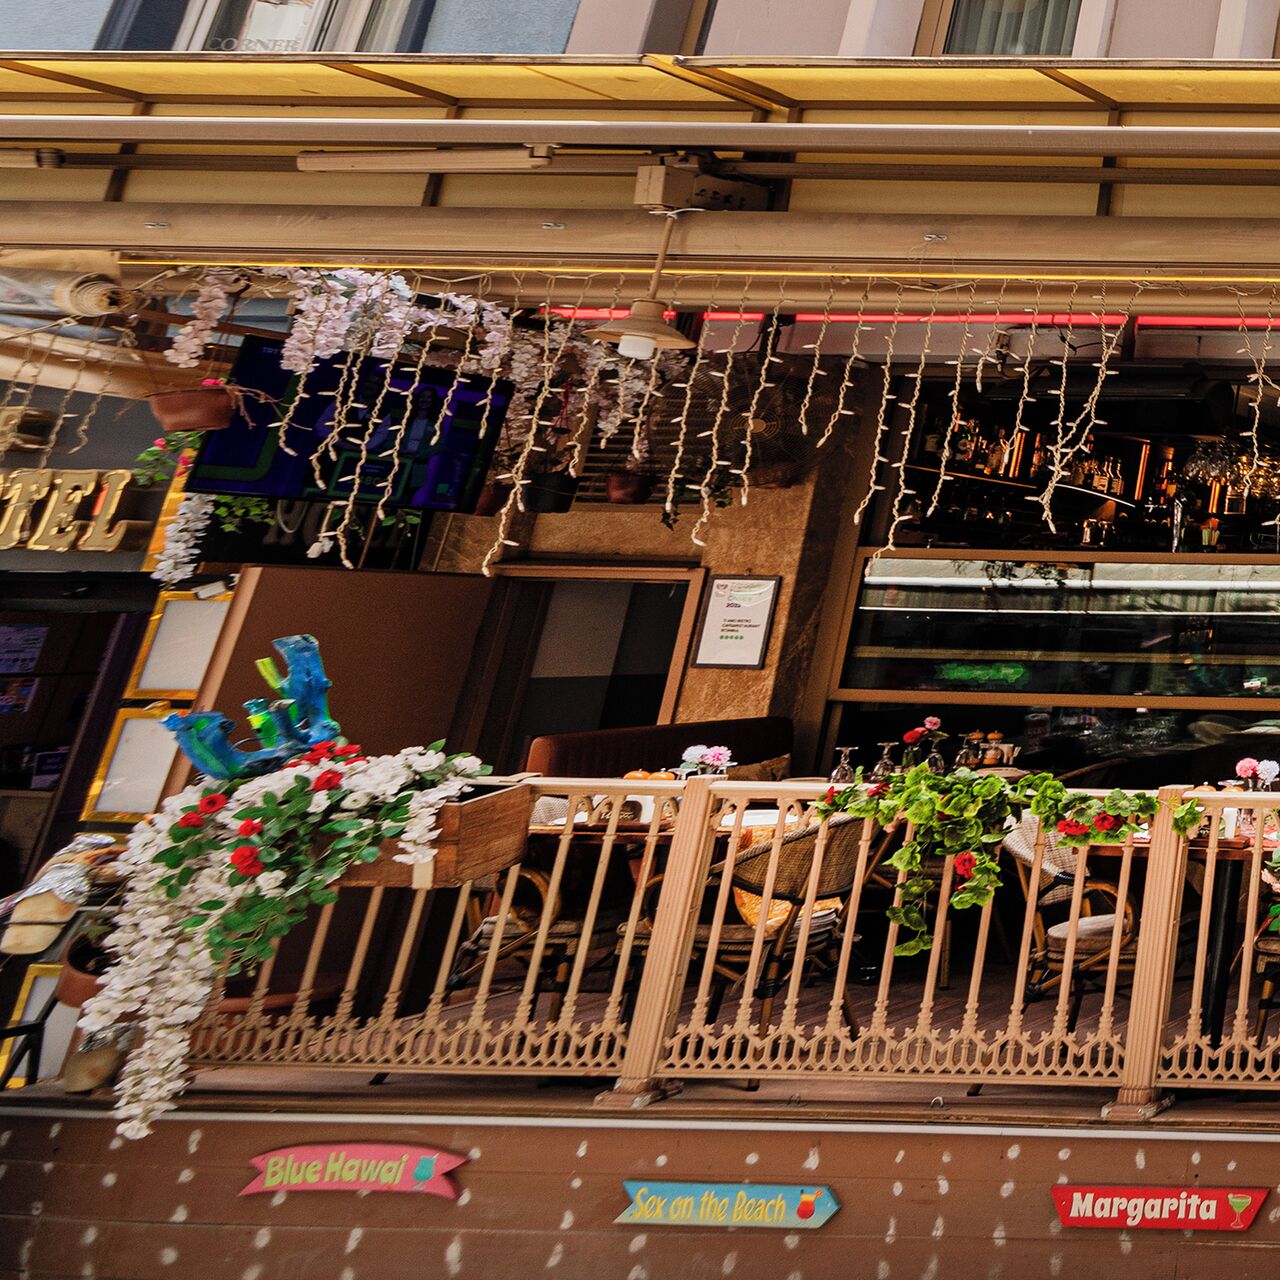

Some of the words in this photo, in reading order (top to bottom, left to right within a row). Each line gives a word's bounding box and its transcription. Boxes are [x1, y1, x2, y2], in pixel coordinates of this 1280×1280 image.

[0, 468, 132, 552] TEL
[264, 1153, 321, 1188] Blue
[323, 1151, 410, 1186] Hawai
[632, 1187, 667, 1220] Sex
[669, 1194, 695, 1220] on
[699, 1188, 730, 1222] the
[733, 1189, 787, 1223] Beach
[1069, 1191, 1218, 1227] Margarita
